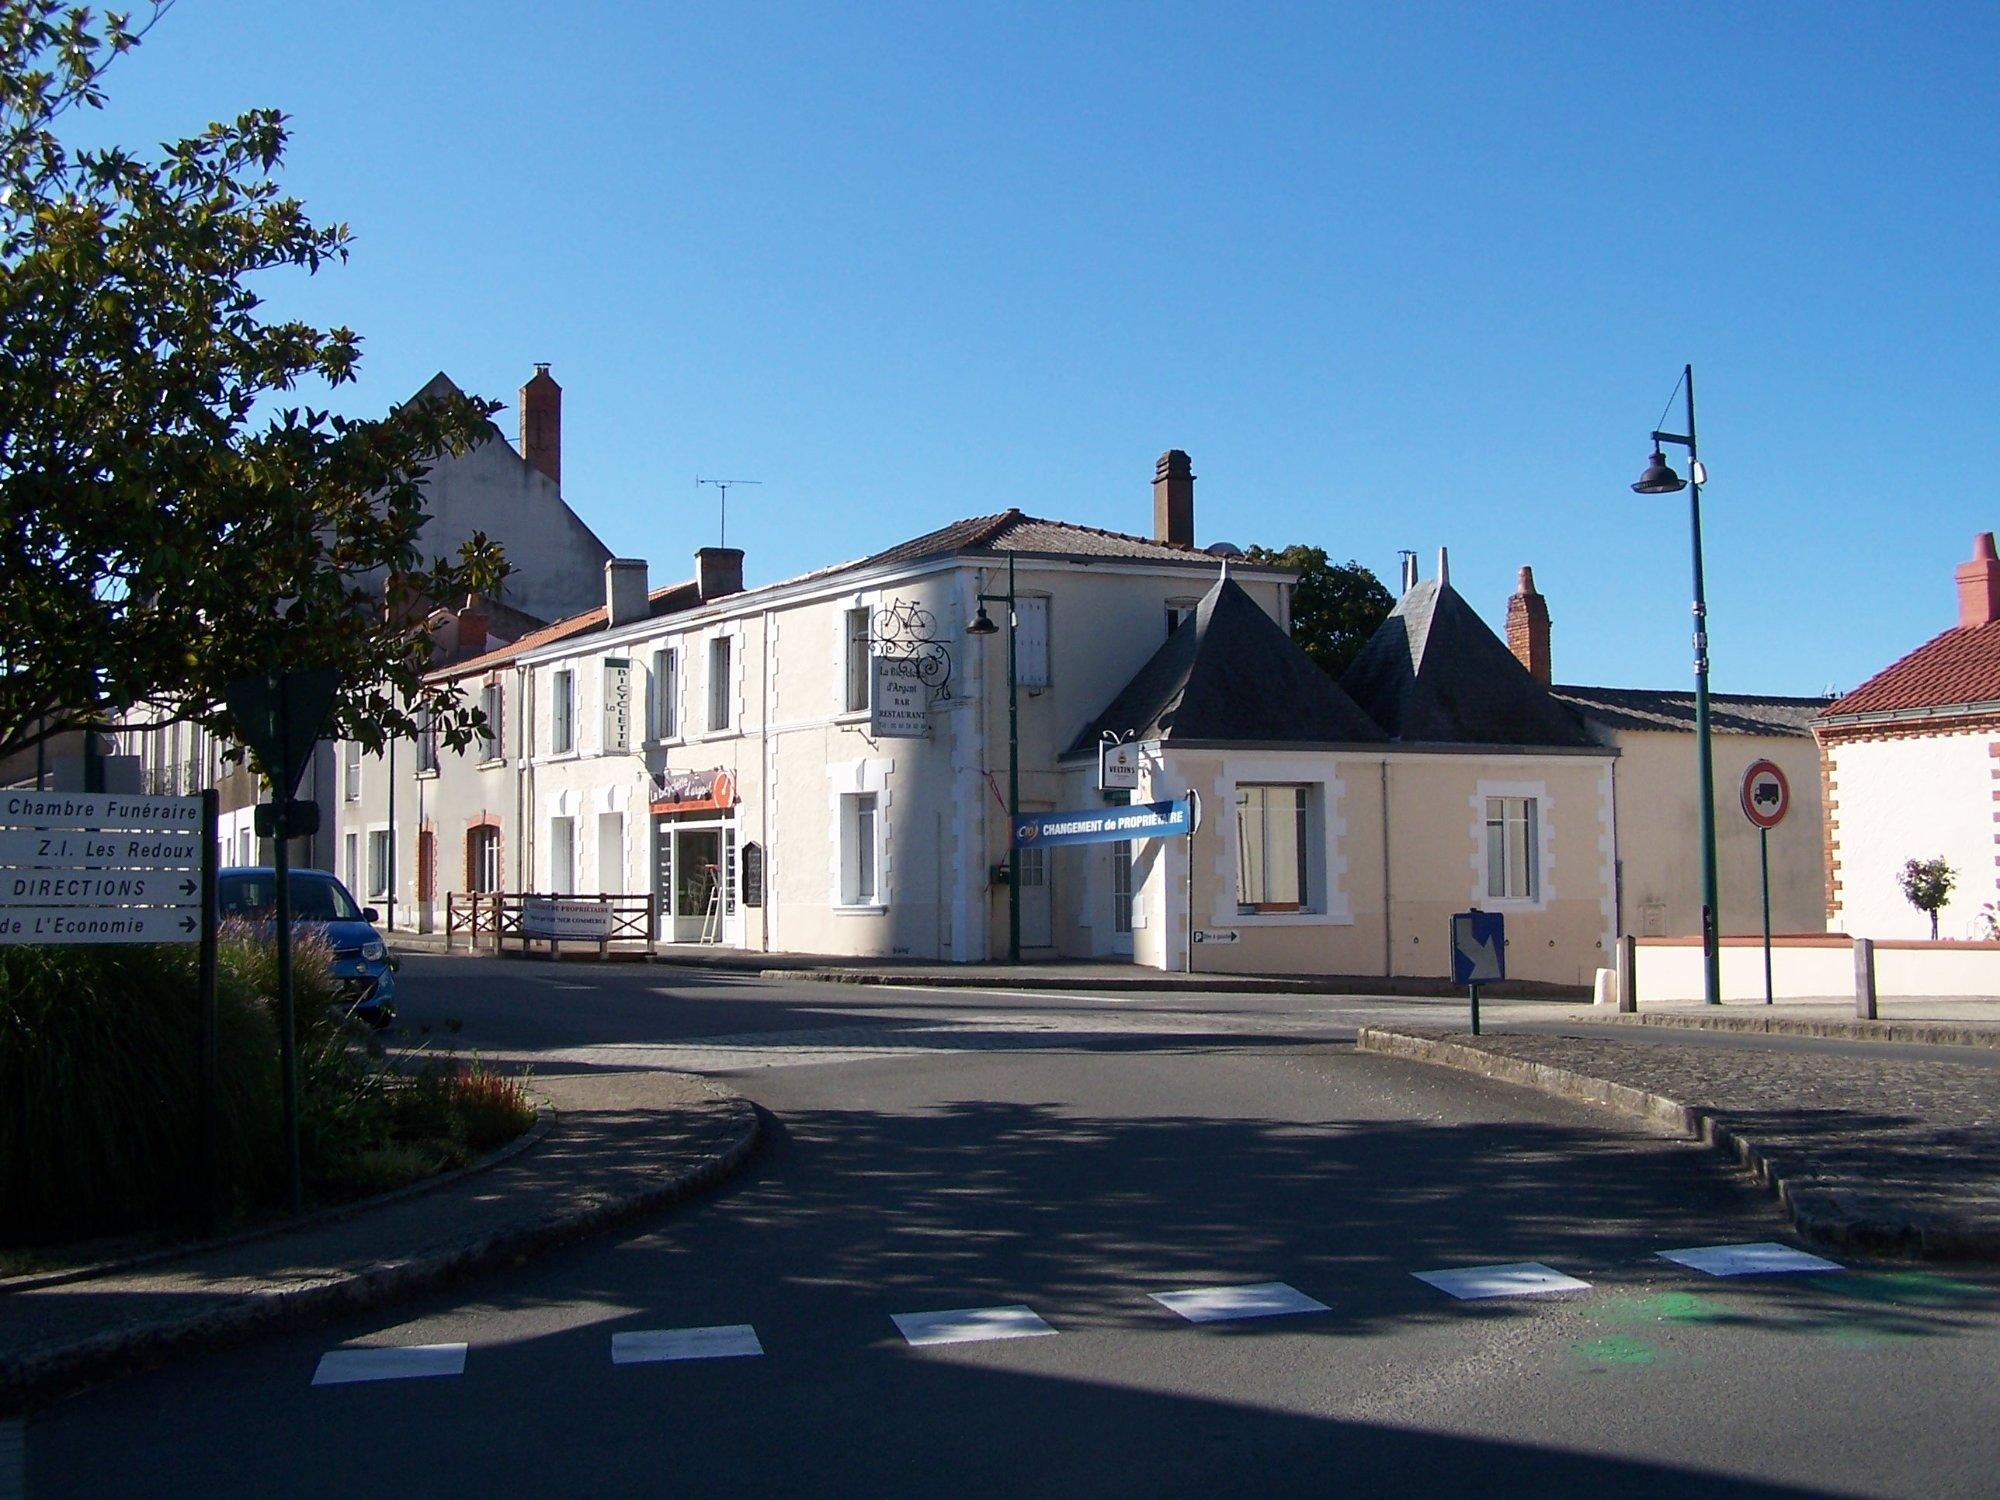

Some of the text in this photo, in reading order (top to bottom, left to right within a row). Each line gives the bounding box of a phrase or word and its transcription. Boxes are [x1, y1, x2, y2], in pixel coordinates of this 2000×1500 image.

[616, 669, 628, 748] BICYCLETTE
[894, 698, 910, 706] BAR
[879, 710, 925, 719] RESTAURANT
[9, 799, 197, 819] Chambre Funéraire
[1043, 820, 1103, 836] CHANGEMENT
[1104, 819, 1117, 831] de
[38, 839, 194, 858] Z.I. Les Redoux
[13, 879, 145, 896] DIRECTIONS
[0, 917, 143, 933] de L'Economie
